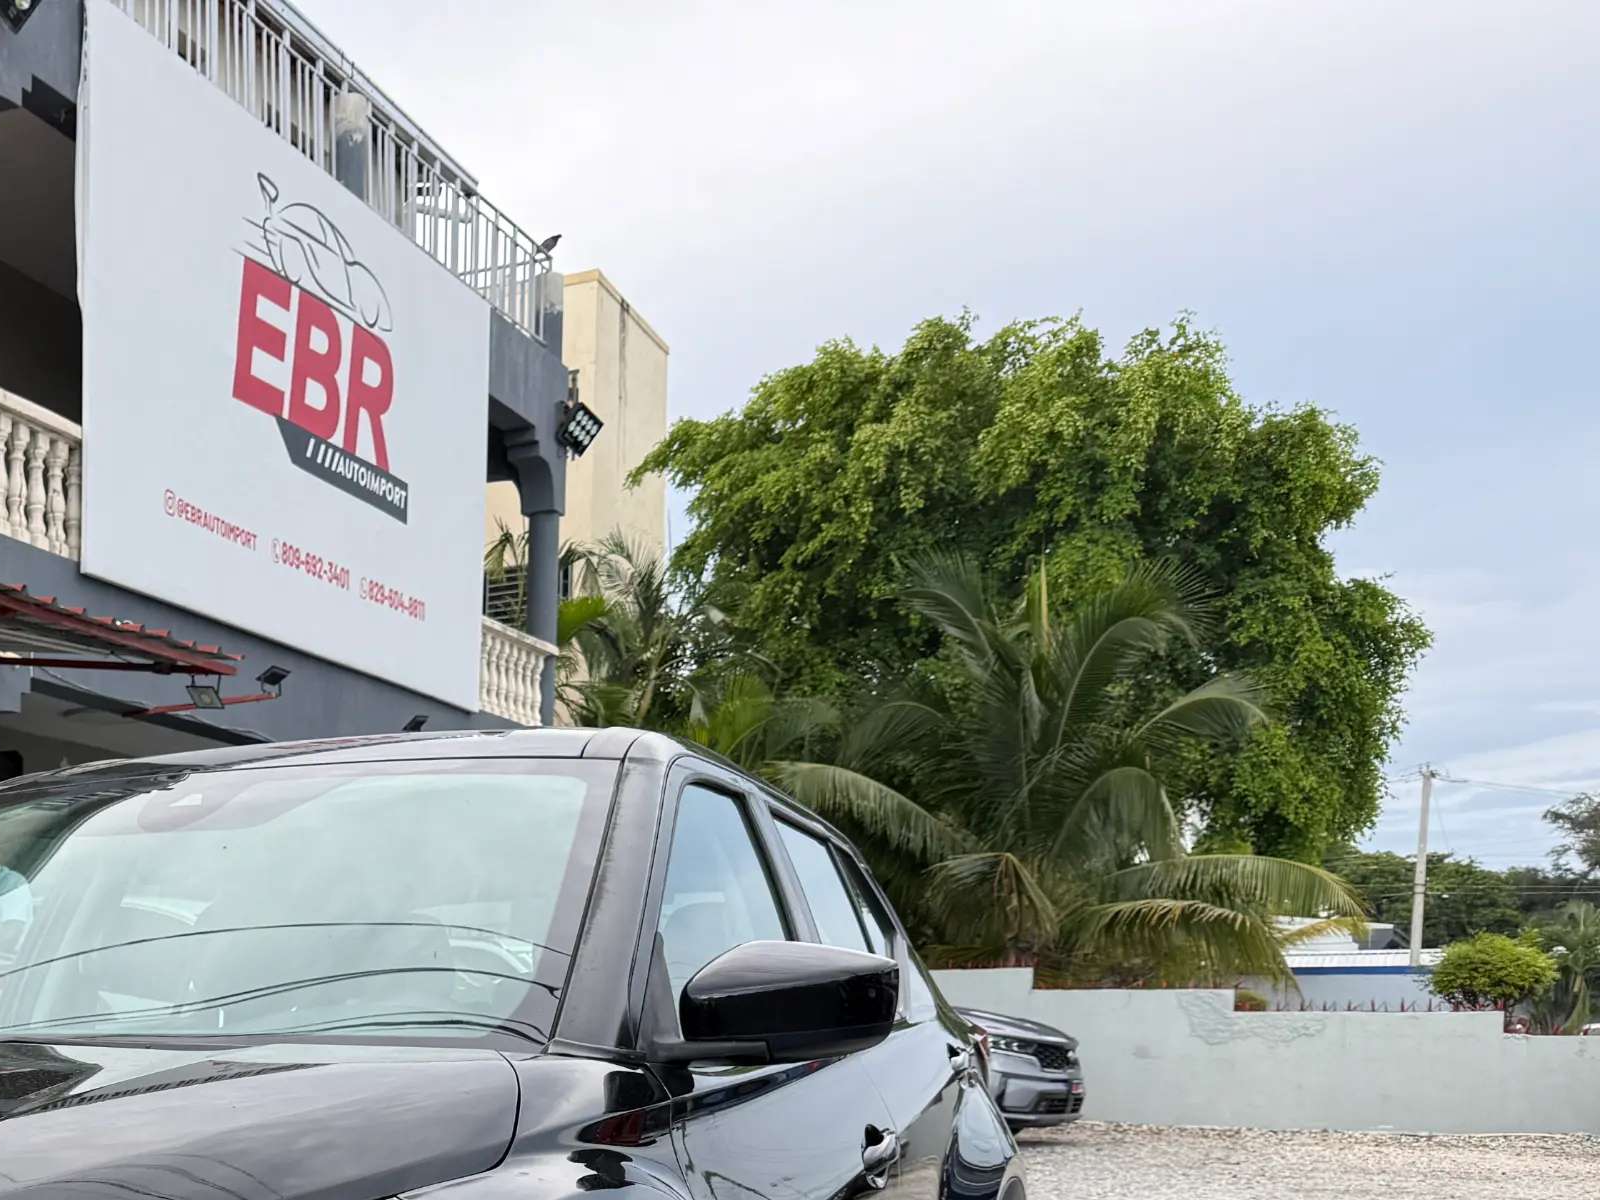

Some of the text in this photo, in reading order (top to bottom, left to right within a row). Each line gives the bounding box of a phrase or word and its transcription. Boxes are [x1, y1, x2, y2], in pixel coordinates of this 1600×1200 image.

[232, 256, 394, 472] EBR
[336, 454, 408, 511] AUTOIMPORT
[177, 498, 257, 551] @EBRAUTOIMPORT
